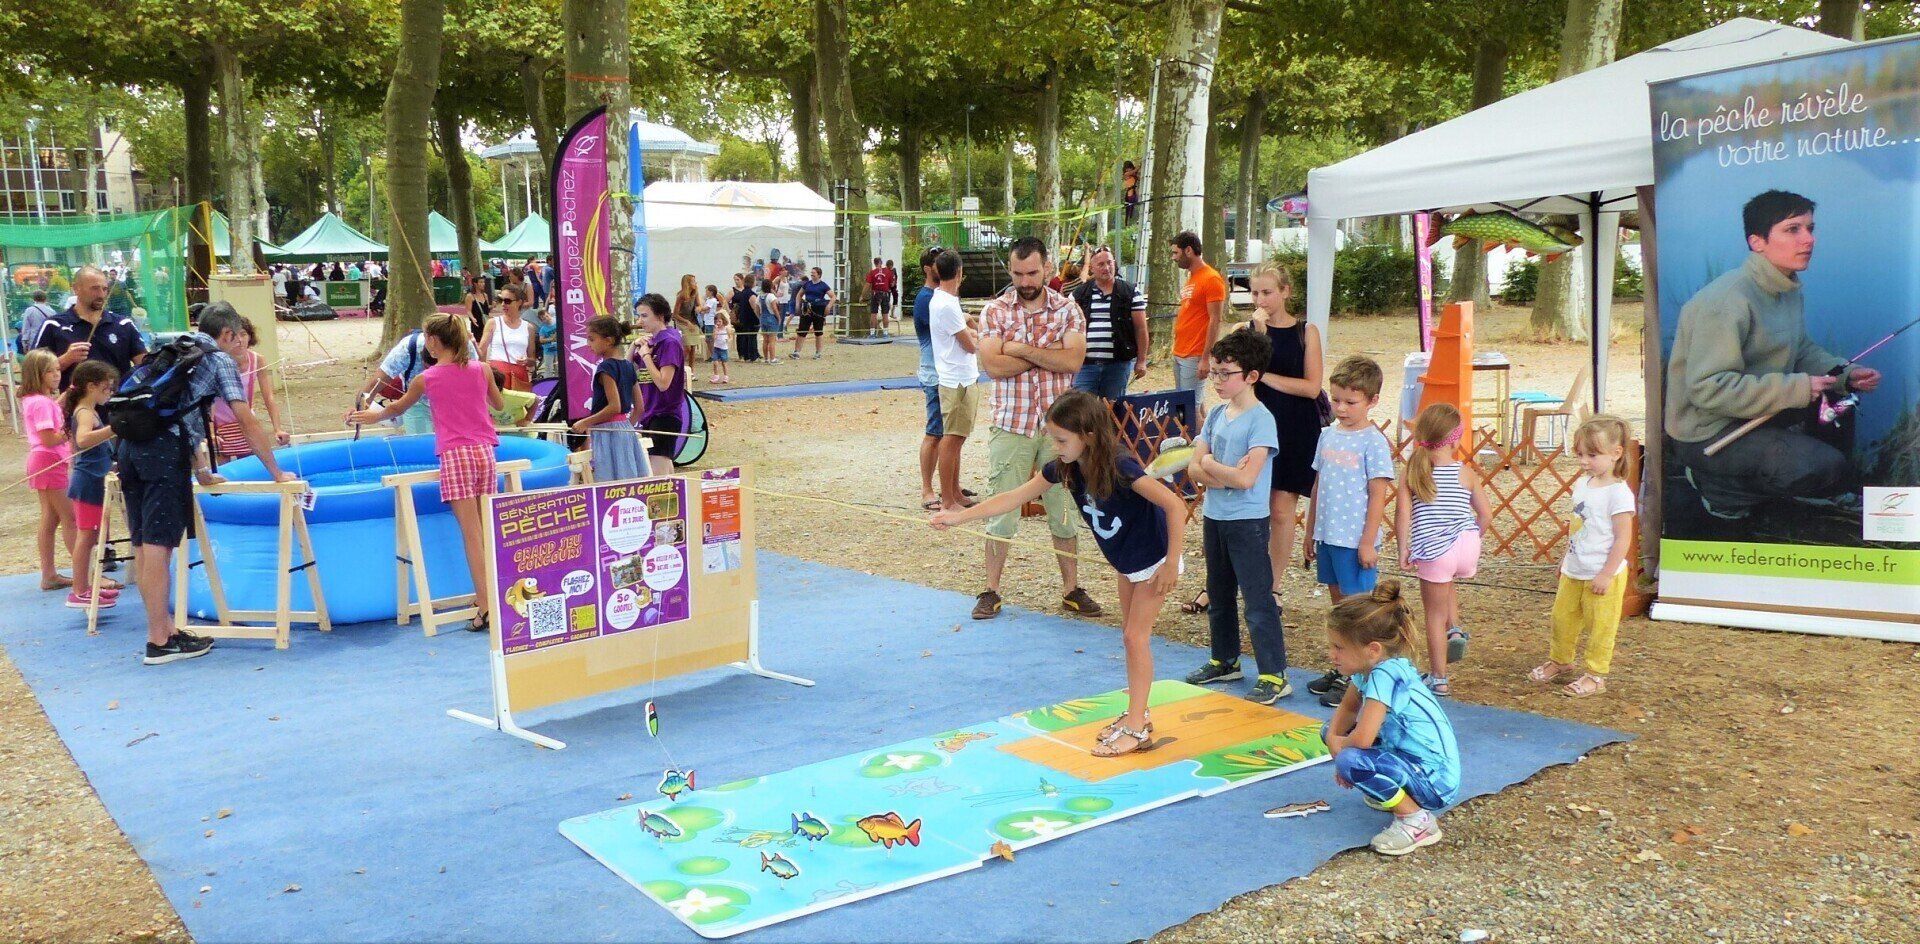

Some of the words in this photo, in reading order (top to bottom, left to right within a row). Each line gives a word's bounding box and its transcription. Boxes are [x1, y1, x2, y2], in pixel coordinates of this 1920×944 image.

[1661, 111, 1689, 141] la
[1698, 96, 1773, 145] pêche
[1780, 82, 1868, 124] révèle
[1719, 139, 1789, 167] votre
[1798, 127, 1920, 157] nature...
[604, 486, 627, 499] LOTS
[628, 485, 636, 497] A
[637, 481, 674, 495] GAGNER
[499, 492, 587, 521] GÉNÉRATION
[501, 503, 589, 539] PÊCHE
[607, 505, 620, 528] 1
[514, 541, 556, 562] GRAND
[560, 533, 582, 550] JEU
[517, 544, 583, 573] CONCOURS
[1682, 548, 1898, 572] www.federationpeche.fr
[646, 558, 656, 573] 5
